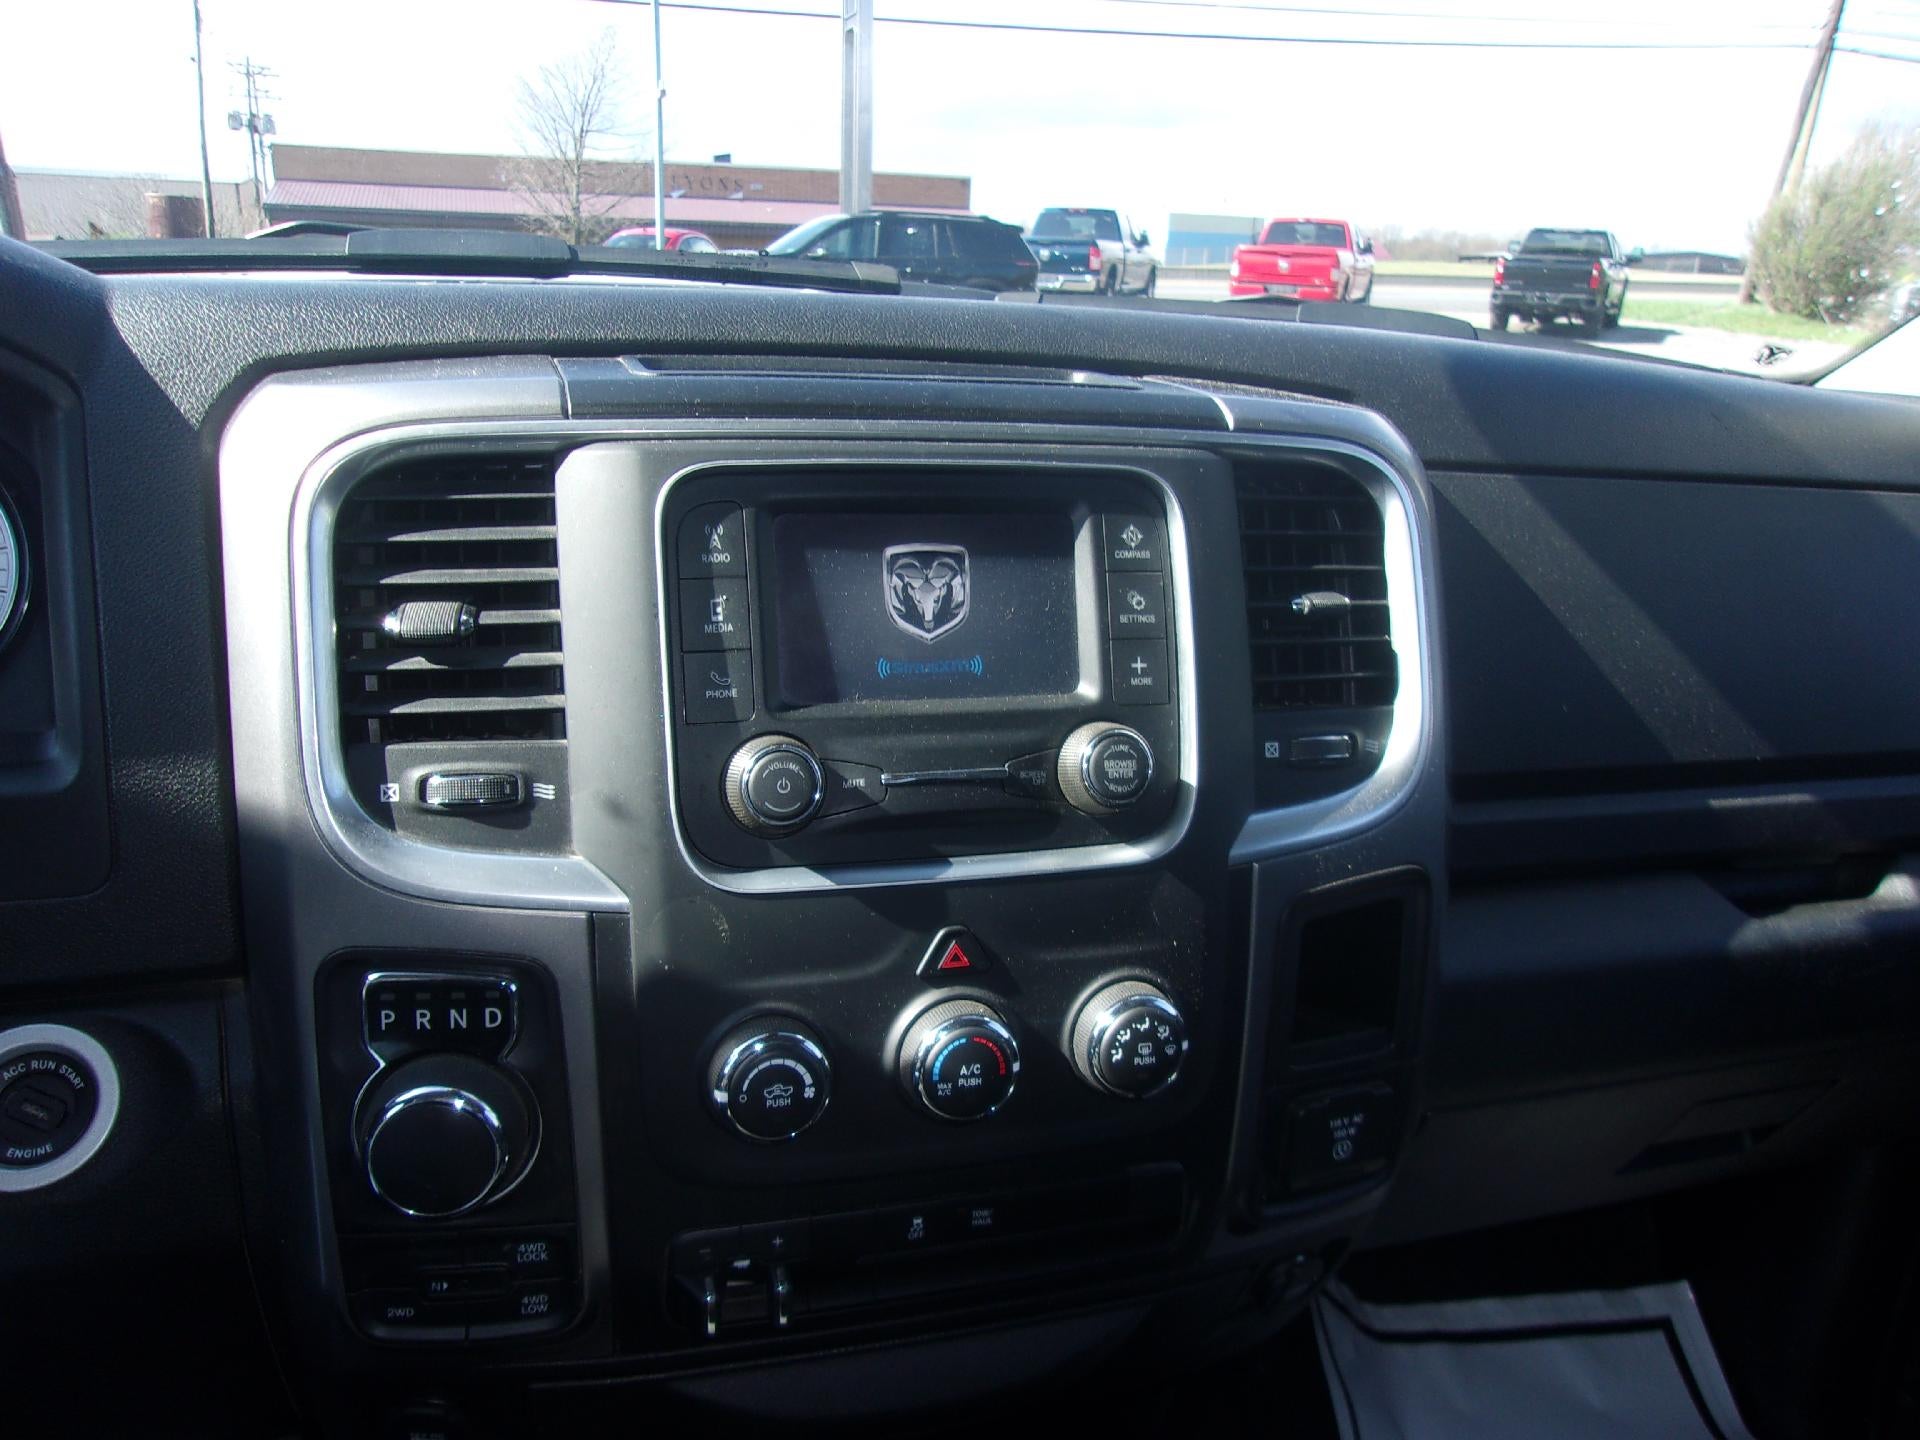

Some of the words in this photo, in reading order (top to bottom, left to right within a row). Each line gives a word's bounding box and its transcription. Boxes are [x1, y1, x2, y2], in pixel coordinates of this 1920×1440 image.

[701, 553, 730, 563] RADIO
[1115, 550, 1150, 559] COMPASS
[1119, 614, 1155, 624] SETTINGS
[704, 622, 733, 633] MEDIA
[1130, 677, 1153, 686] MORE
[705, 688, 738, 699] PHONE
[1111, 743, 1129, 752] TUNE
[768, 761, 800, 774] VOLUME
[1104, 759, 1137, 769] BROWSE
[1108, 770, 1134, 779] ENTER
[842, 778, 866, 789] MUTE
[1108, 783, 1135, 793] SCROLL
[380, 1009, 396, 1031] P
[415, 1008, 432, 1031] R
[449, 1007, 468, 1030] N
[484, 1007, 503, 1029] D
[1134, 1056, 1156, 1066] PUSH
[3, 1062, 26, 1081] ACC
[31, 1060, 56, 1071] RUN
[59, 1064, 85, 1090] START
[959, 1063, 981, 1076] A/C
[958, 1077, 983, 1087] PUSH
[766, 1097, 792, 1109] PUSH
[6, 1143, 54, 1159] ENGINE
[517, 1242, 546, 1253] 4WD
[516, 1251, 549, 1264] LOCK
[521, 1293, 549, 1304] 4WD
[386, 1306, 415, 1318] 2WD
[520, 1303, 550, 1315] LOW
